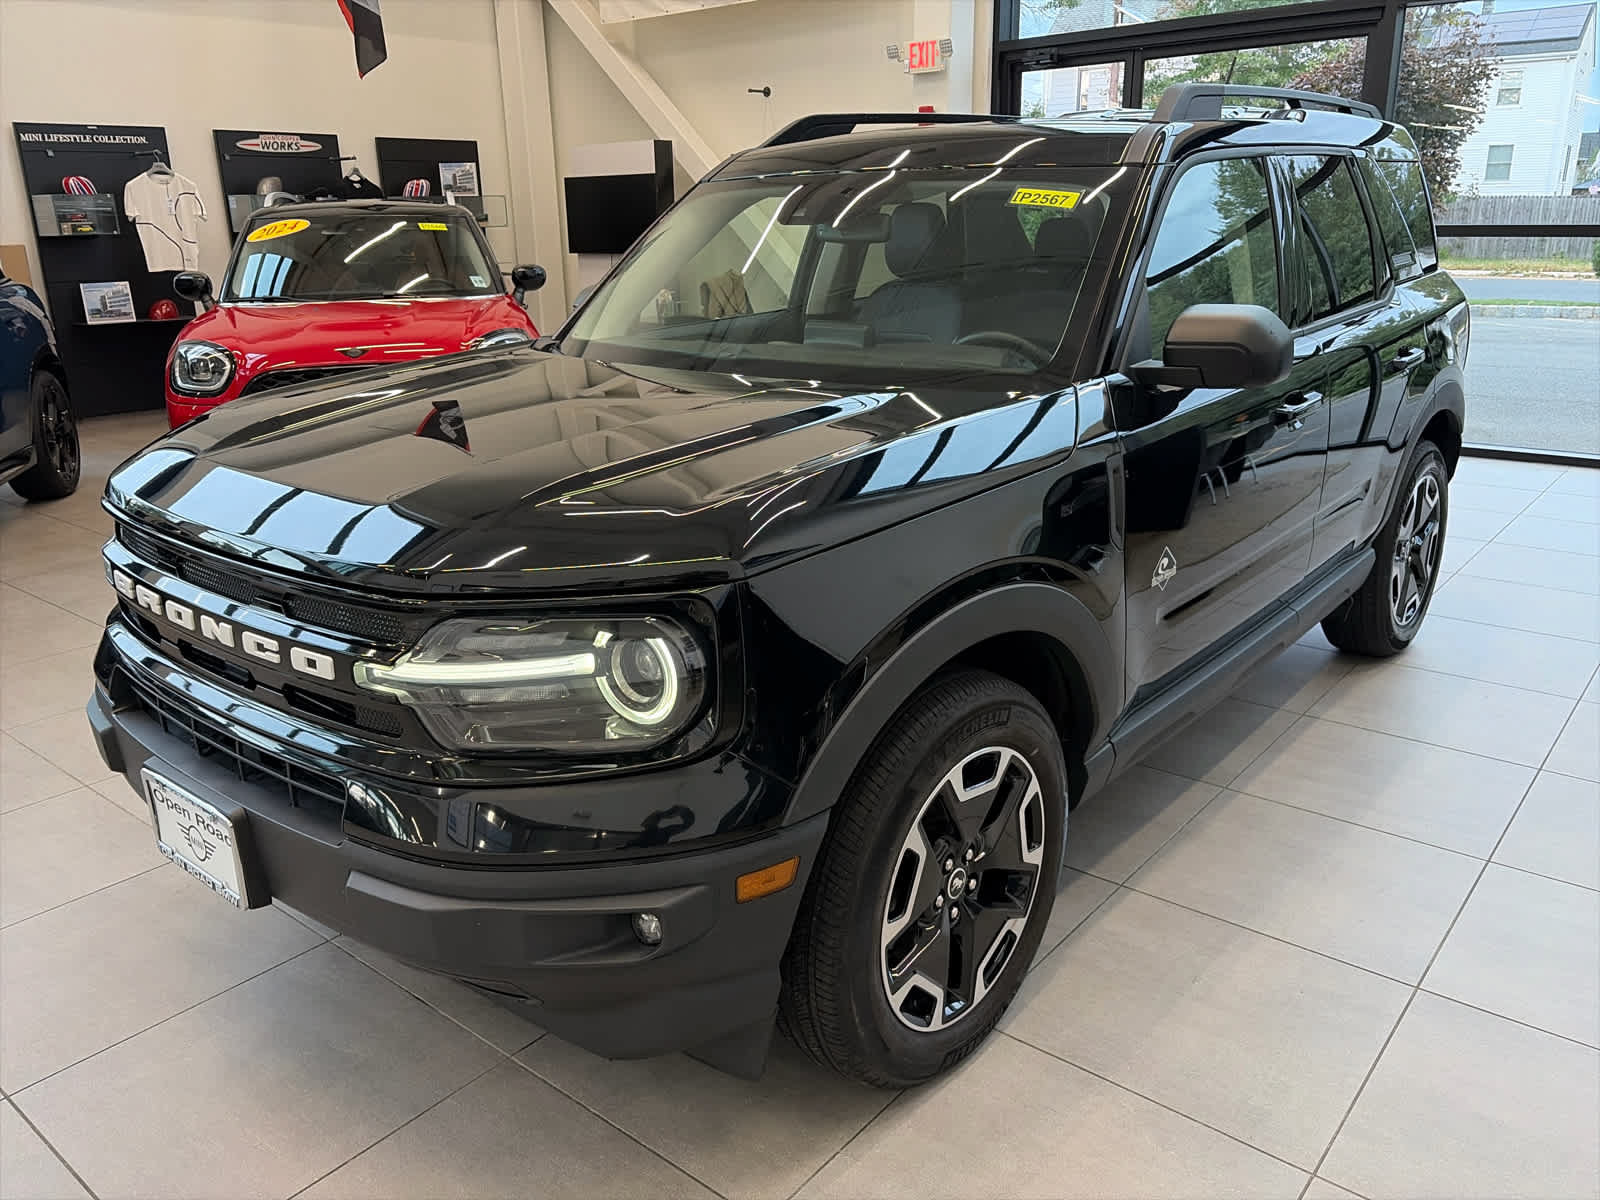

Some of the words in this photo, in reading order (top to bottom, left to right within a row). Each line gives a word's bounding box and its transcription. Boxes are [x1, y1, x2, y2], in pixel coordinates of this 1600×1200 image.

[909, 40, 937, 69] EXIT
[19, 132, 43, 142] MINI
[44, 133, 93, 143] LIFESTYLE
[260, 140, 301, 151] WORKS
[256, 221, 300, 239] 2024
[112, 569, 337, 681] BRONCO
[943, 707, 1011, 750] CHELIN
[153, 788, 191, 820] Open
